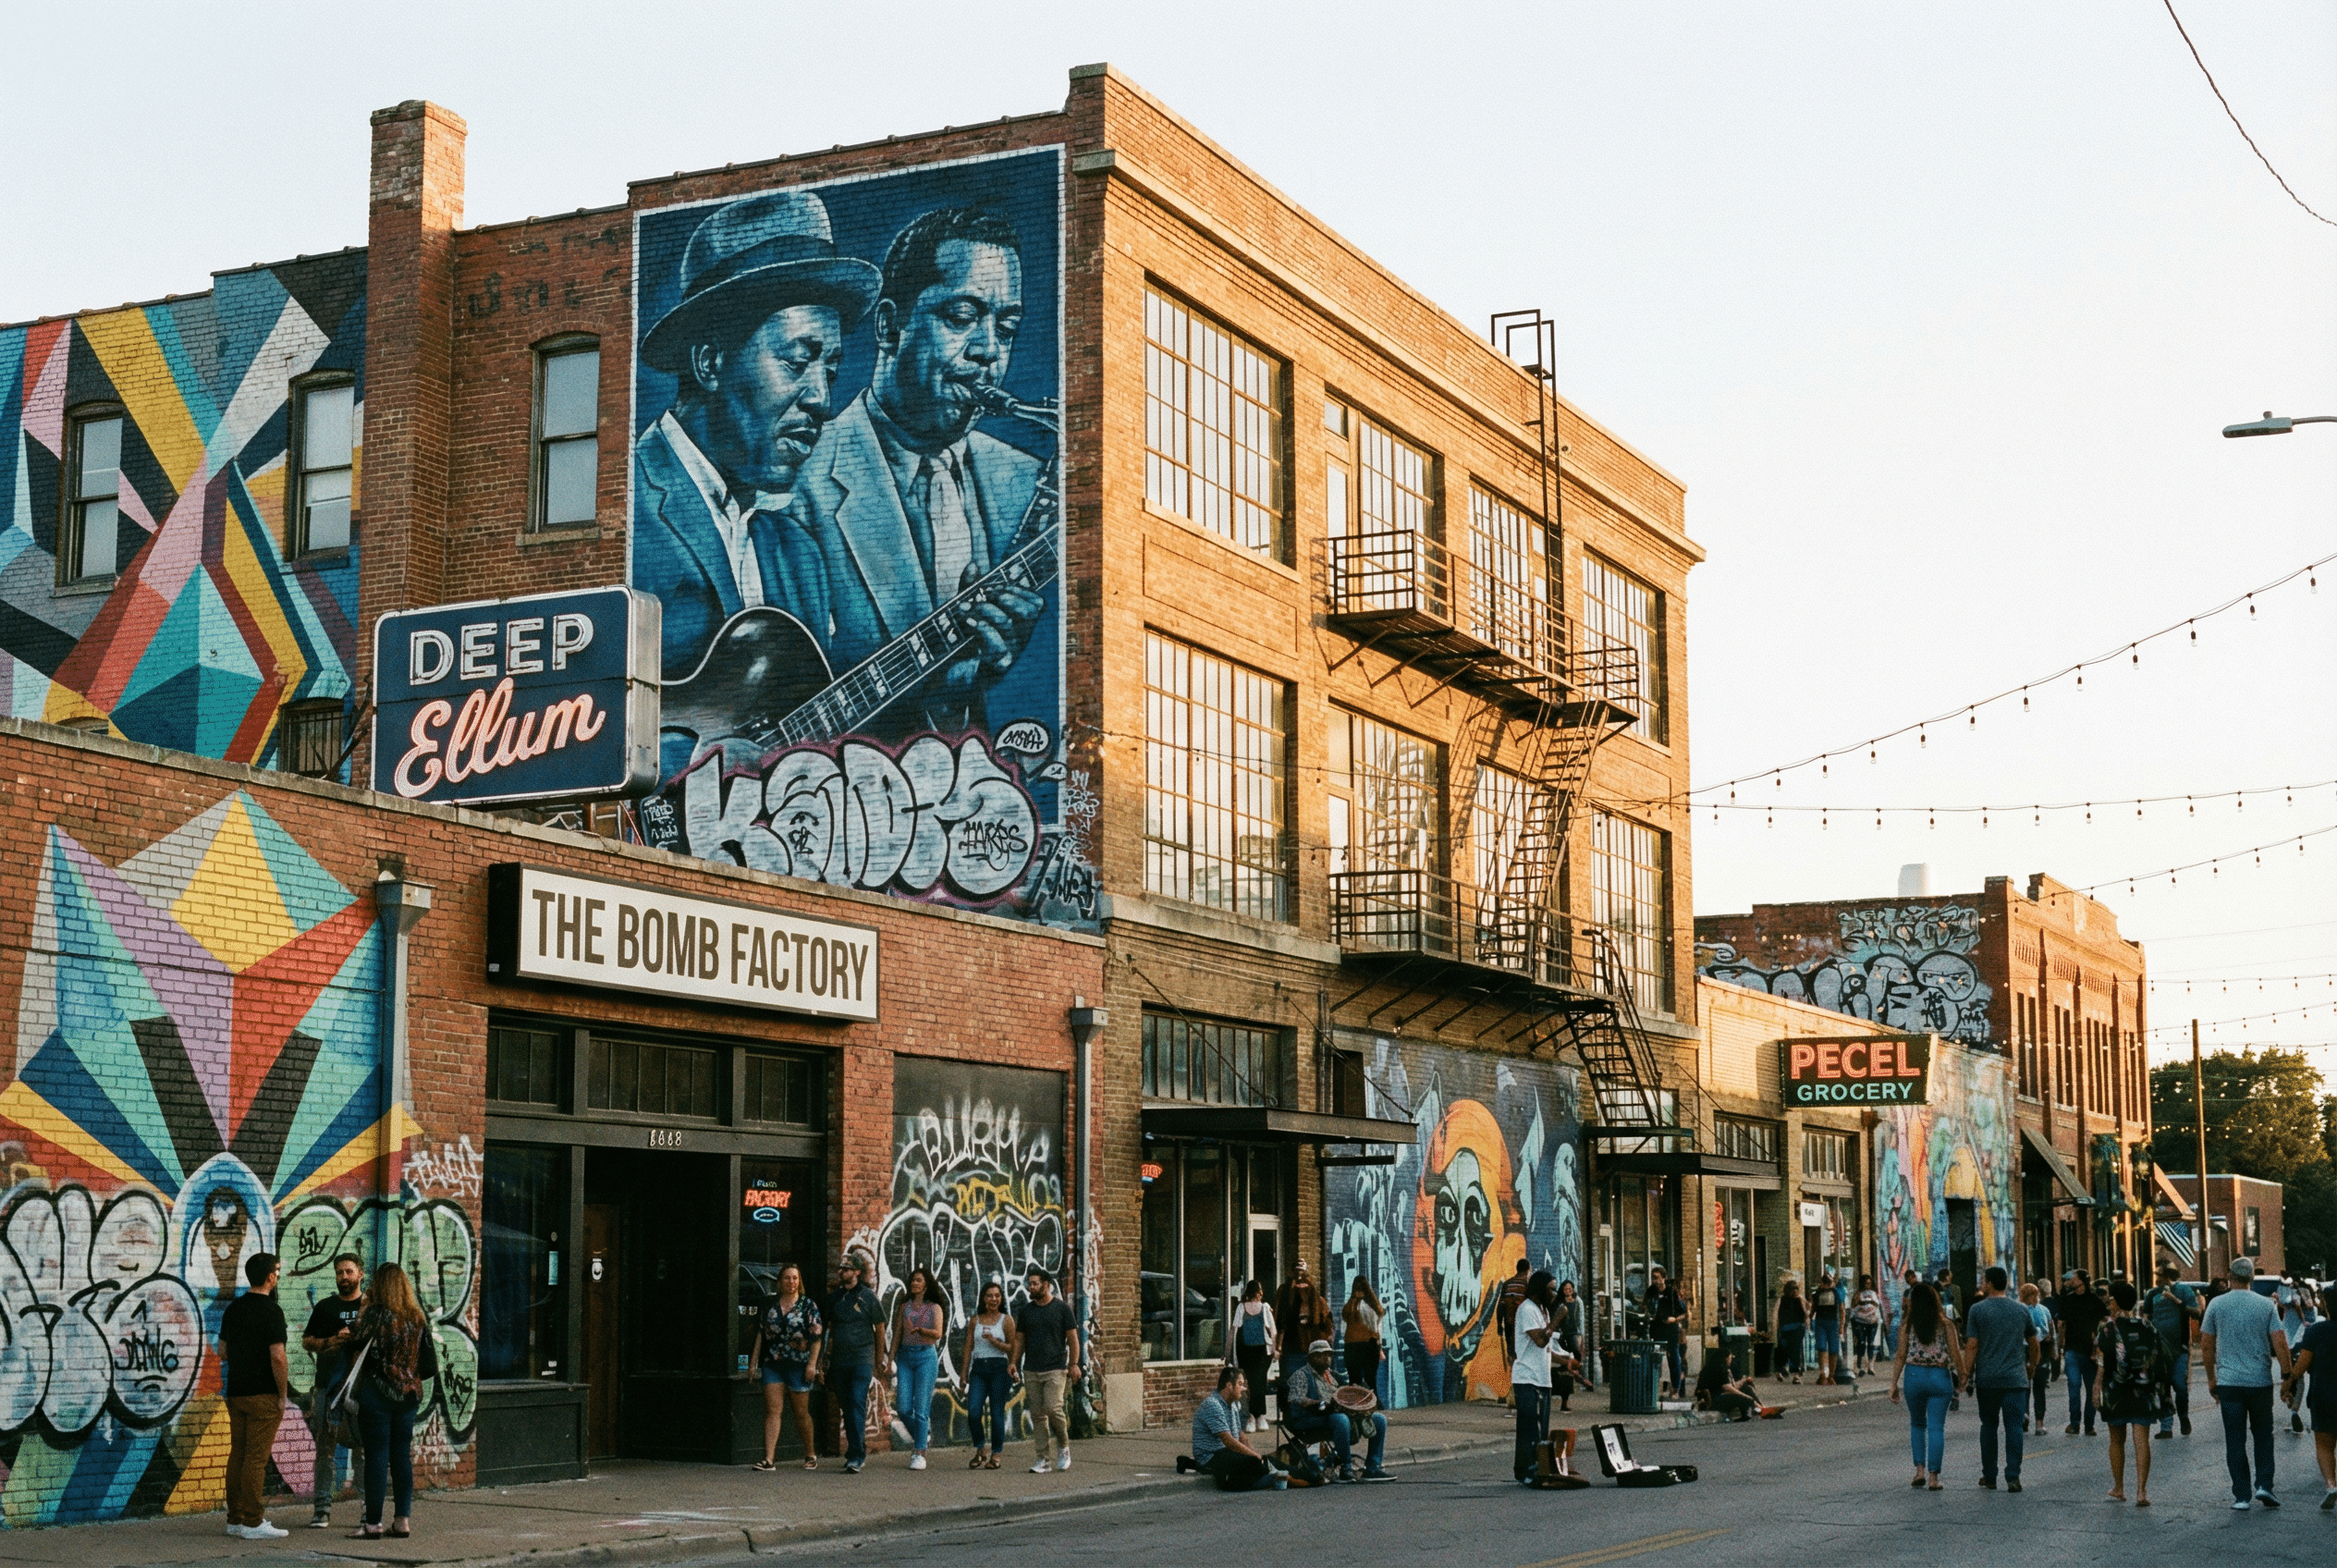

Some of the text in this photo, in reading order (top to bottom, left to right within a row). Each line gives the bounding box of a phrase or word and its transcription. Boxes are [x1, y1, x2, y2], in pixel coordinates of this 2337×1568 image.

[410, 613, 593, 686] DEEP
[394, 677, 606, 798] Ellum
[532, 888, 869, 1001] THE BOMB FACTORY
[1791, 1042, 1921, 1080] PECEL
[1797, 1082, 1914, 1101] GROCERY
